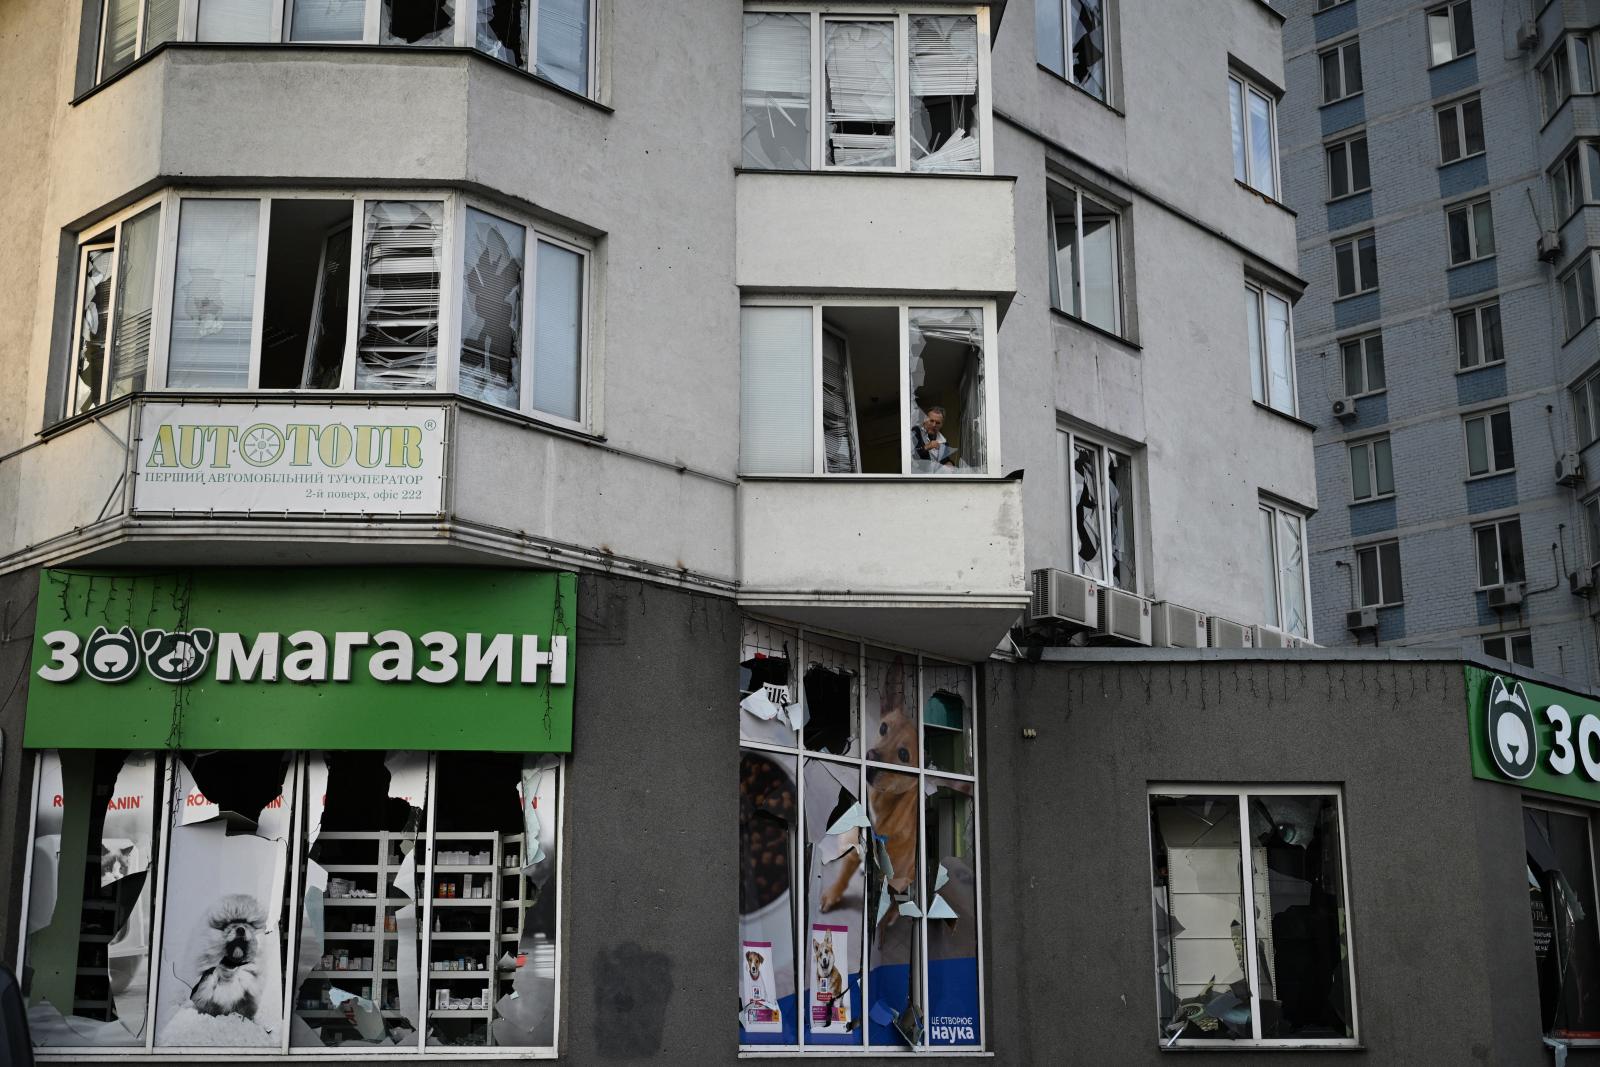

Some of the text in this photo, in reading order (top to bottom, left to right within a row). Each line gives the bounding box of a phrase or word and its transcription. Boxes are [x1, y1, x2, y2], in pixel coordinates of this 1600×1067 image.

[145, 470, 424, 486] ПЕРШИЙ АВТОМОБІЛЬНИЙ ТУРОПЕРАТОР
[305, 488, 423, 502] 2-й поверх, офіс 222
[931, 1016, 973, 1025] ЦЕ СТВОРЮЄ
[931, 1025, 975, 1044] наука
